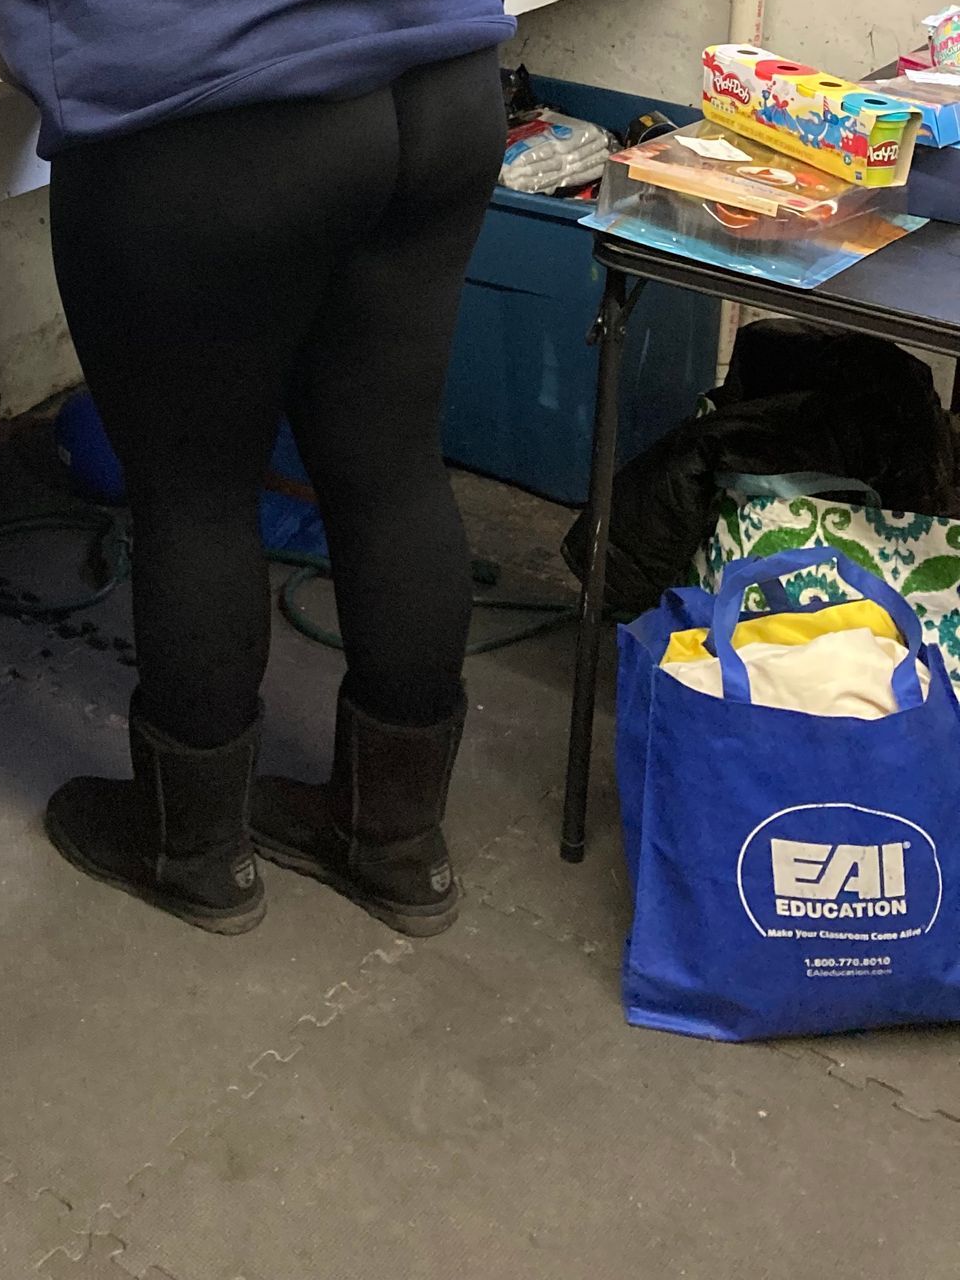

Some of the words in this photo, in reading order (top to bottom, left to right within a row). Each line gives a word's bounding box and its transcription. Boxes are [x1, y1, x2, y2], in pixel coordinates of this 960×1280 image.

[713, 76, 750, 103] Play-Doh
[771, 838, 906, 900] EAI
[775, 899, 907, 919] EDUCATION
[767, 929, 793, 938] Make
[795, 929, 817, 939] Your
[819, 929, 869, 941] Classroom
[871, 931, 897, 941] Come
